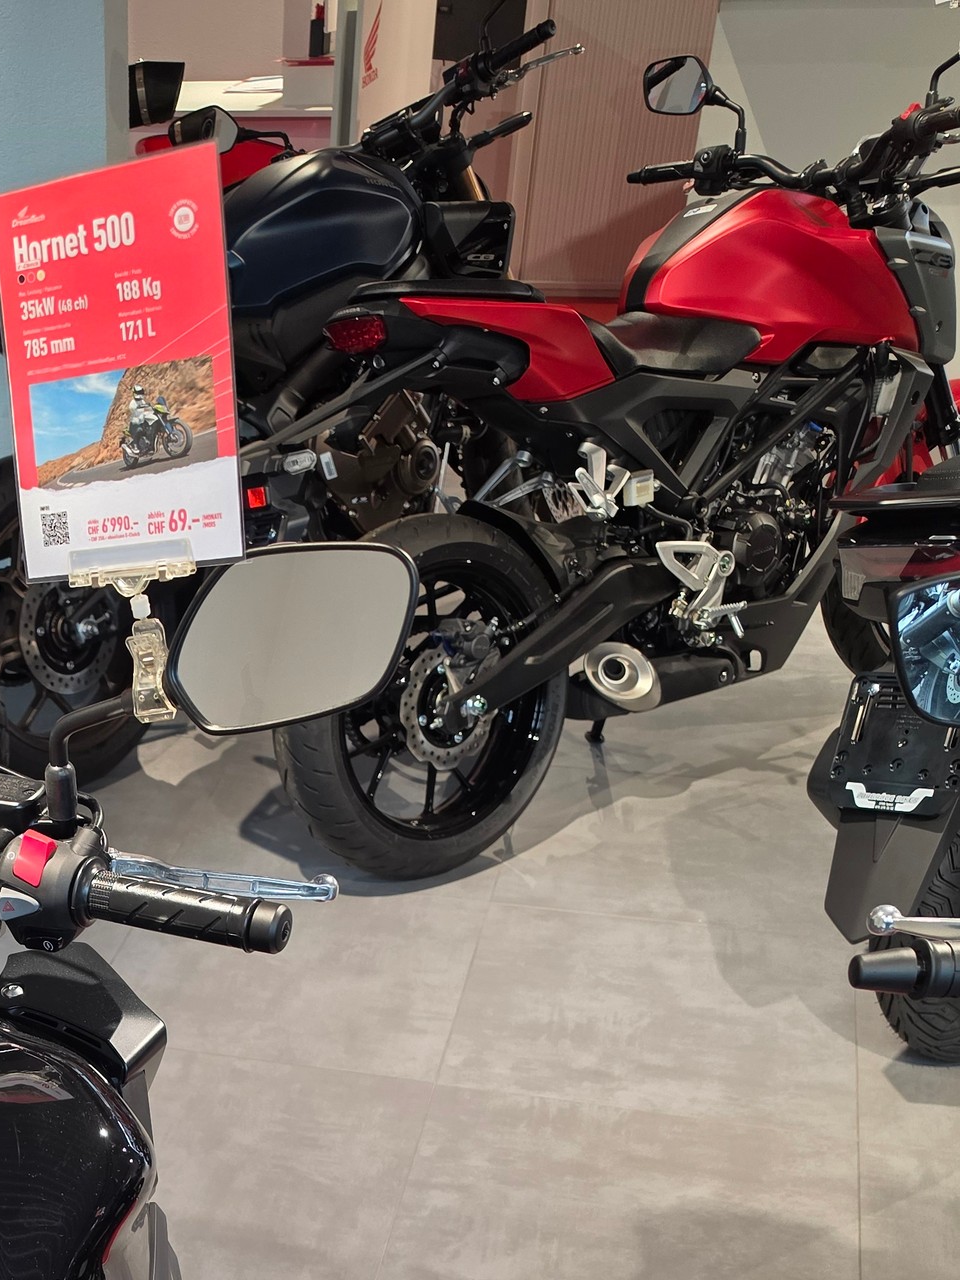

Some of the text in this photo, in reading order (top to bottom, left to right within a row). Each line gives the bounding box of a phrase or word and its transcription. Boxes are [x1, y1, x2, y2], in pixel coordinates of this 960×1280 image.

[13, 224, 89, 264] Hornet
[92, 212, 136, 252] 500
[116, 276, 162, 303] 188 Kg
[20, 294, 89, 321] 35kW (48 ch)
[119, 317, 157, 342] 17,1 L
[24, 336, 76, 359] 785 mm
[88, 515, 139, 535] CHF 6'990.-
[147, 508, 200, 535] CHF 69.-
